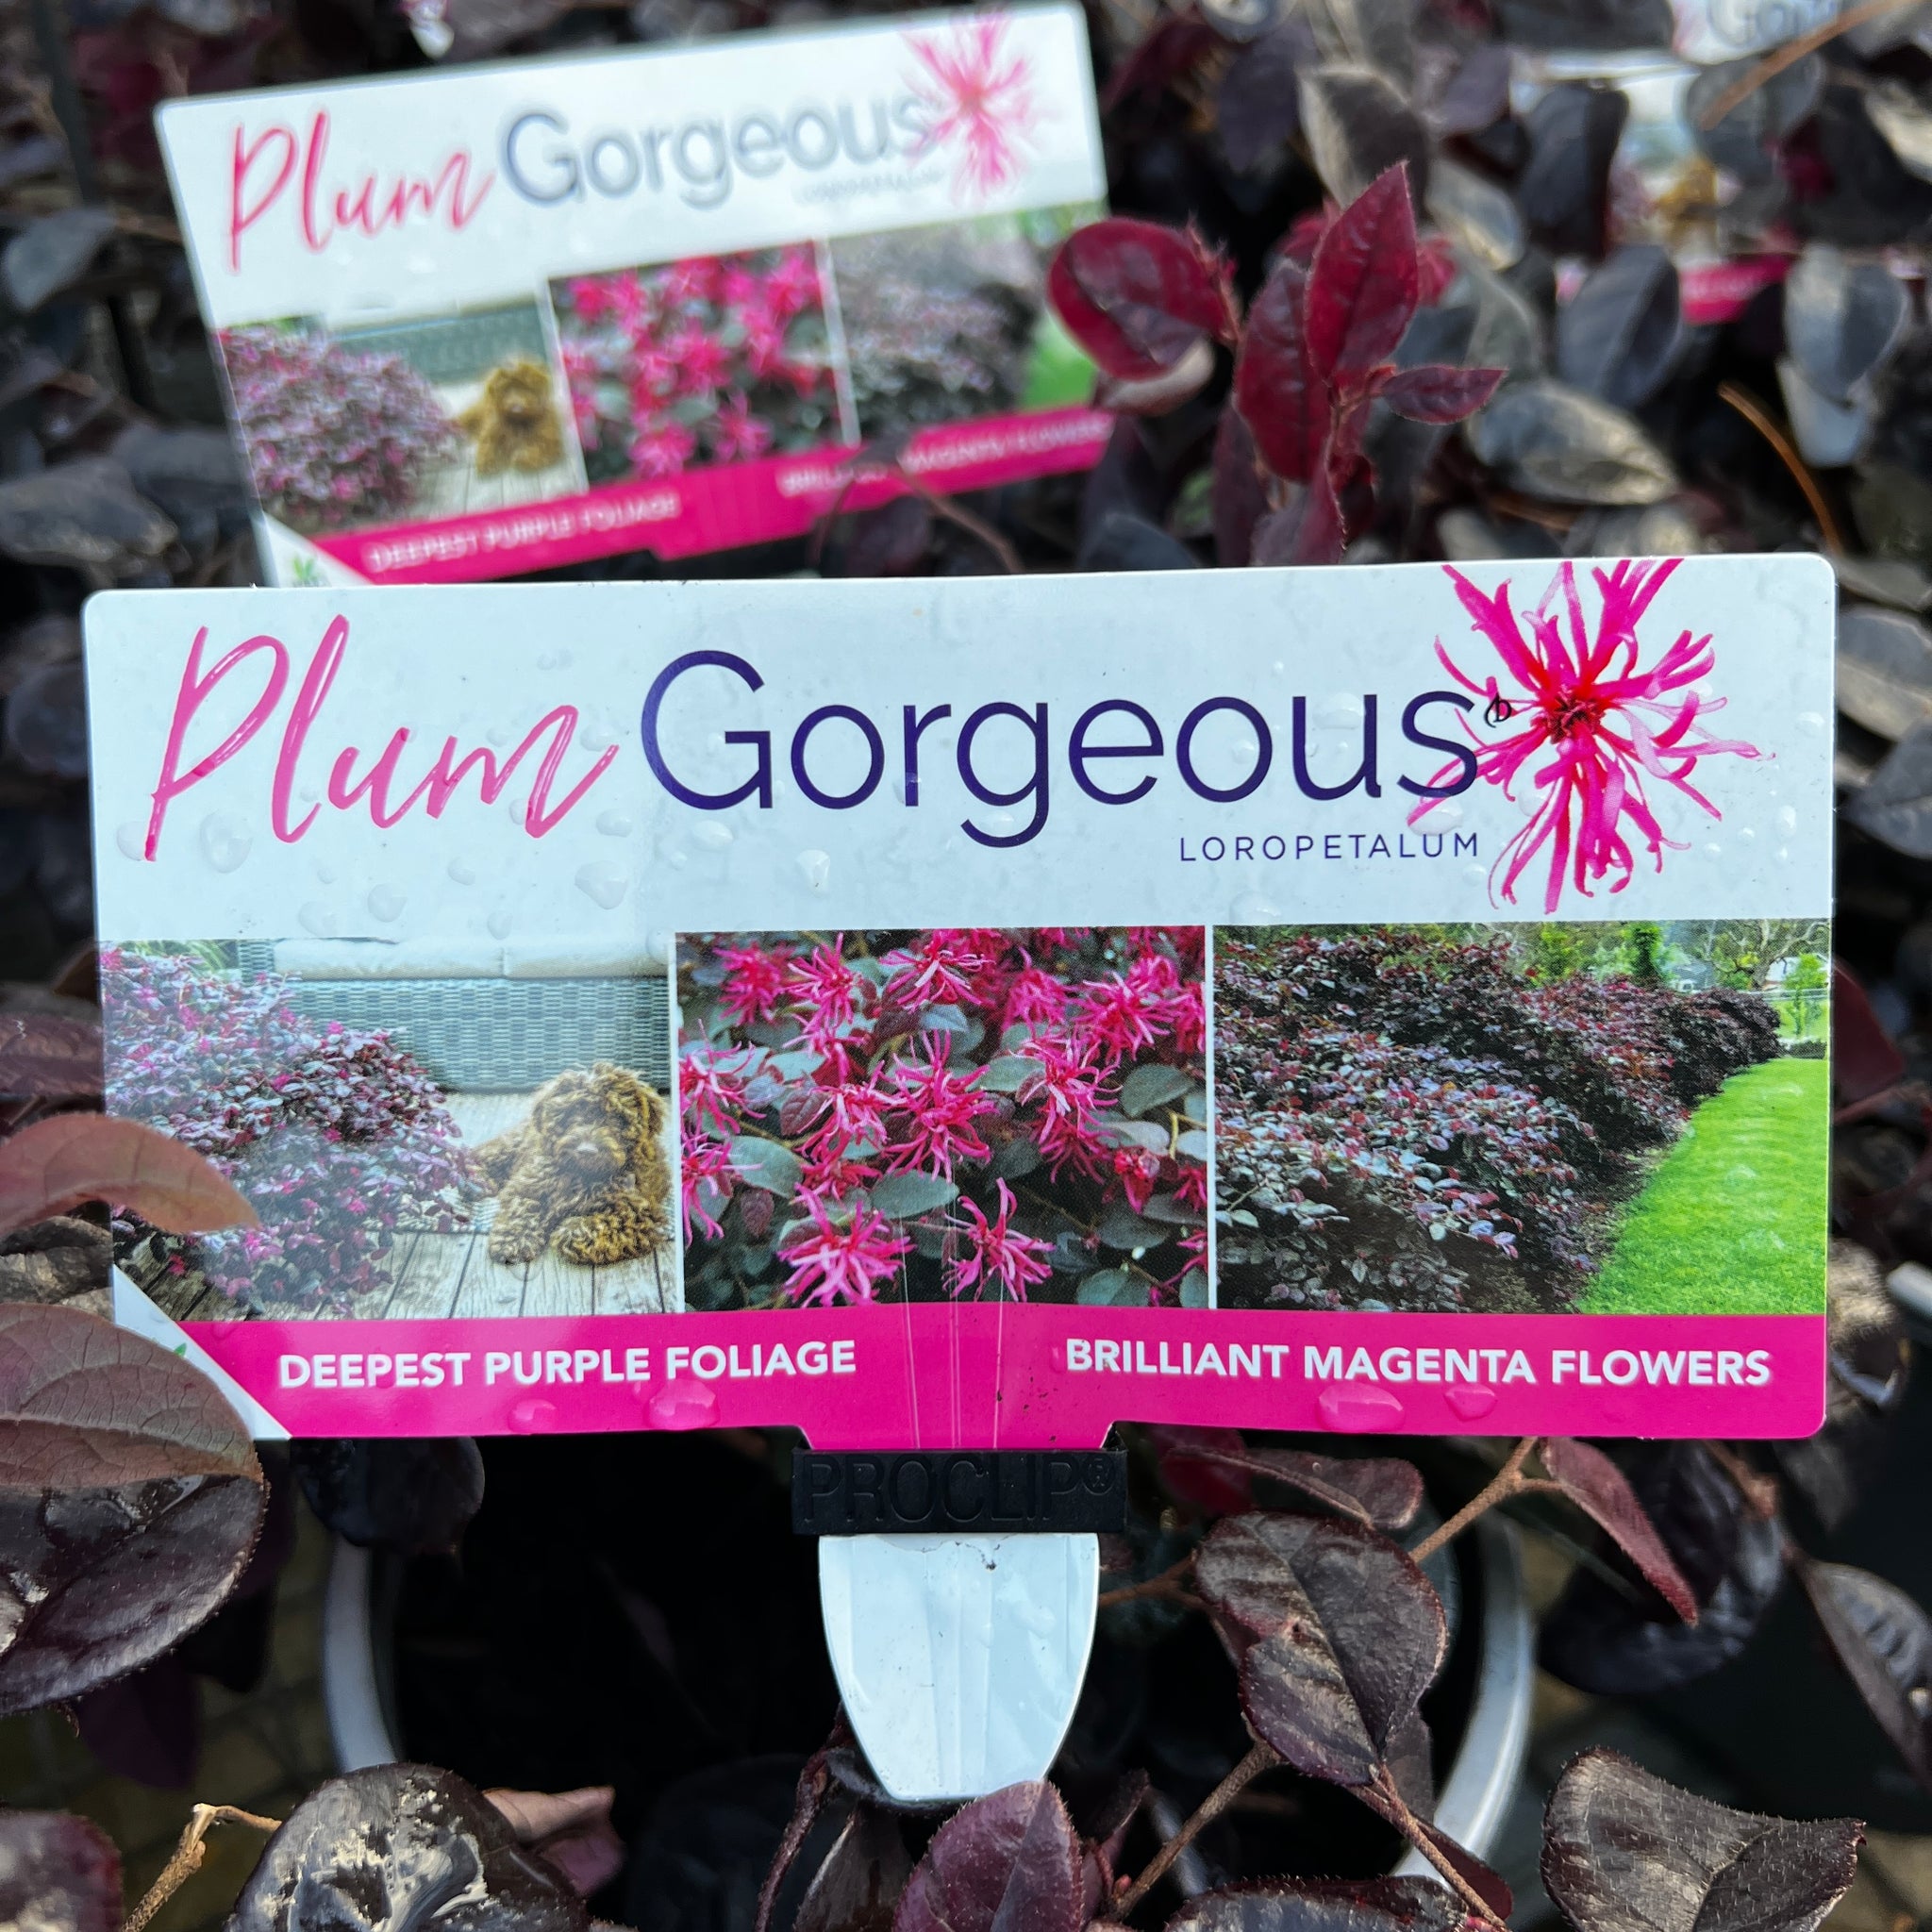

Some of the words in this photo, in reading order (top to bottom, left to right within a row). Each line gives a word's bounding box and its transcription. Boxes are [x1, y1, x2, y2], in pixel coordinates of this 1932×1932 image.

[226, 107, 497, 272] Plum
[497, 94, 941, 210] Gorgeous
[144, 614, 620, 862] Plum
[641, 650, 1478, 848] Gorgeous
[1180, 833, 1478, 862] LOROPETALUM
[278, 1353, 472, 1389] DEEPEST
[483, 1348, 651, 1386] PURPLE
[665, 1341, 857, 1380] FOLIAGE
[1065, 1338, 1290, 1378] BRILLIANT
[1303, 1345, 1537, 1384] MAGENTA
[1551, 1349, 1772, 1386] FLOWERS
